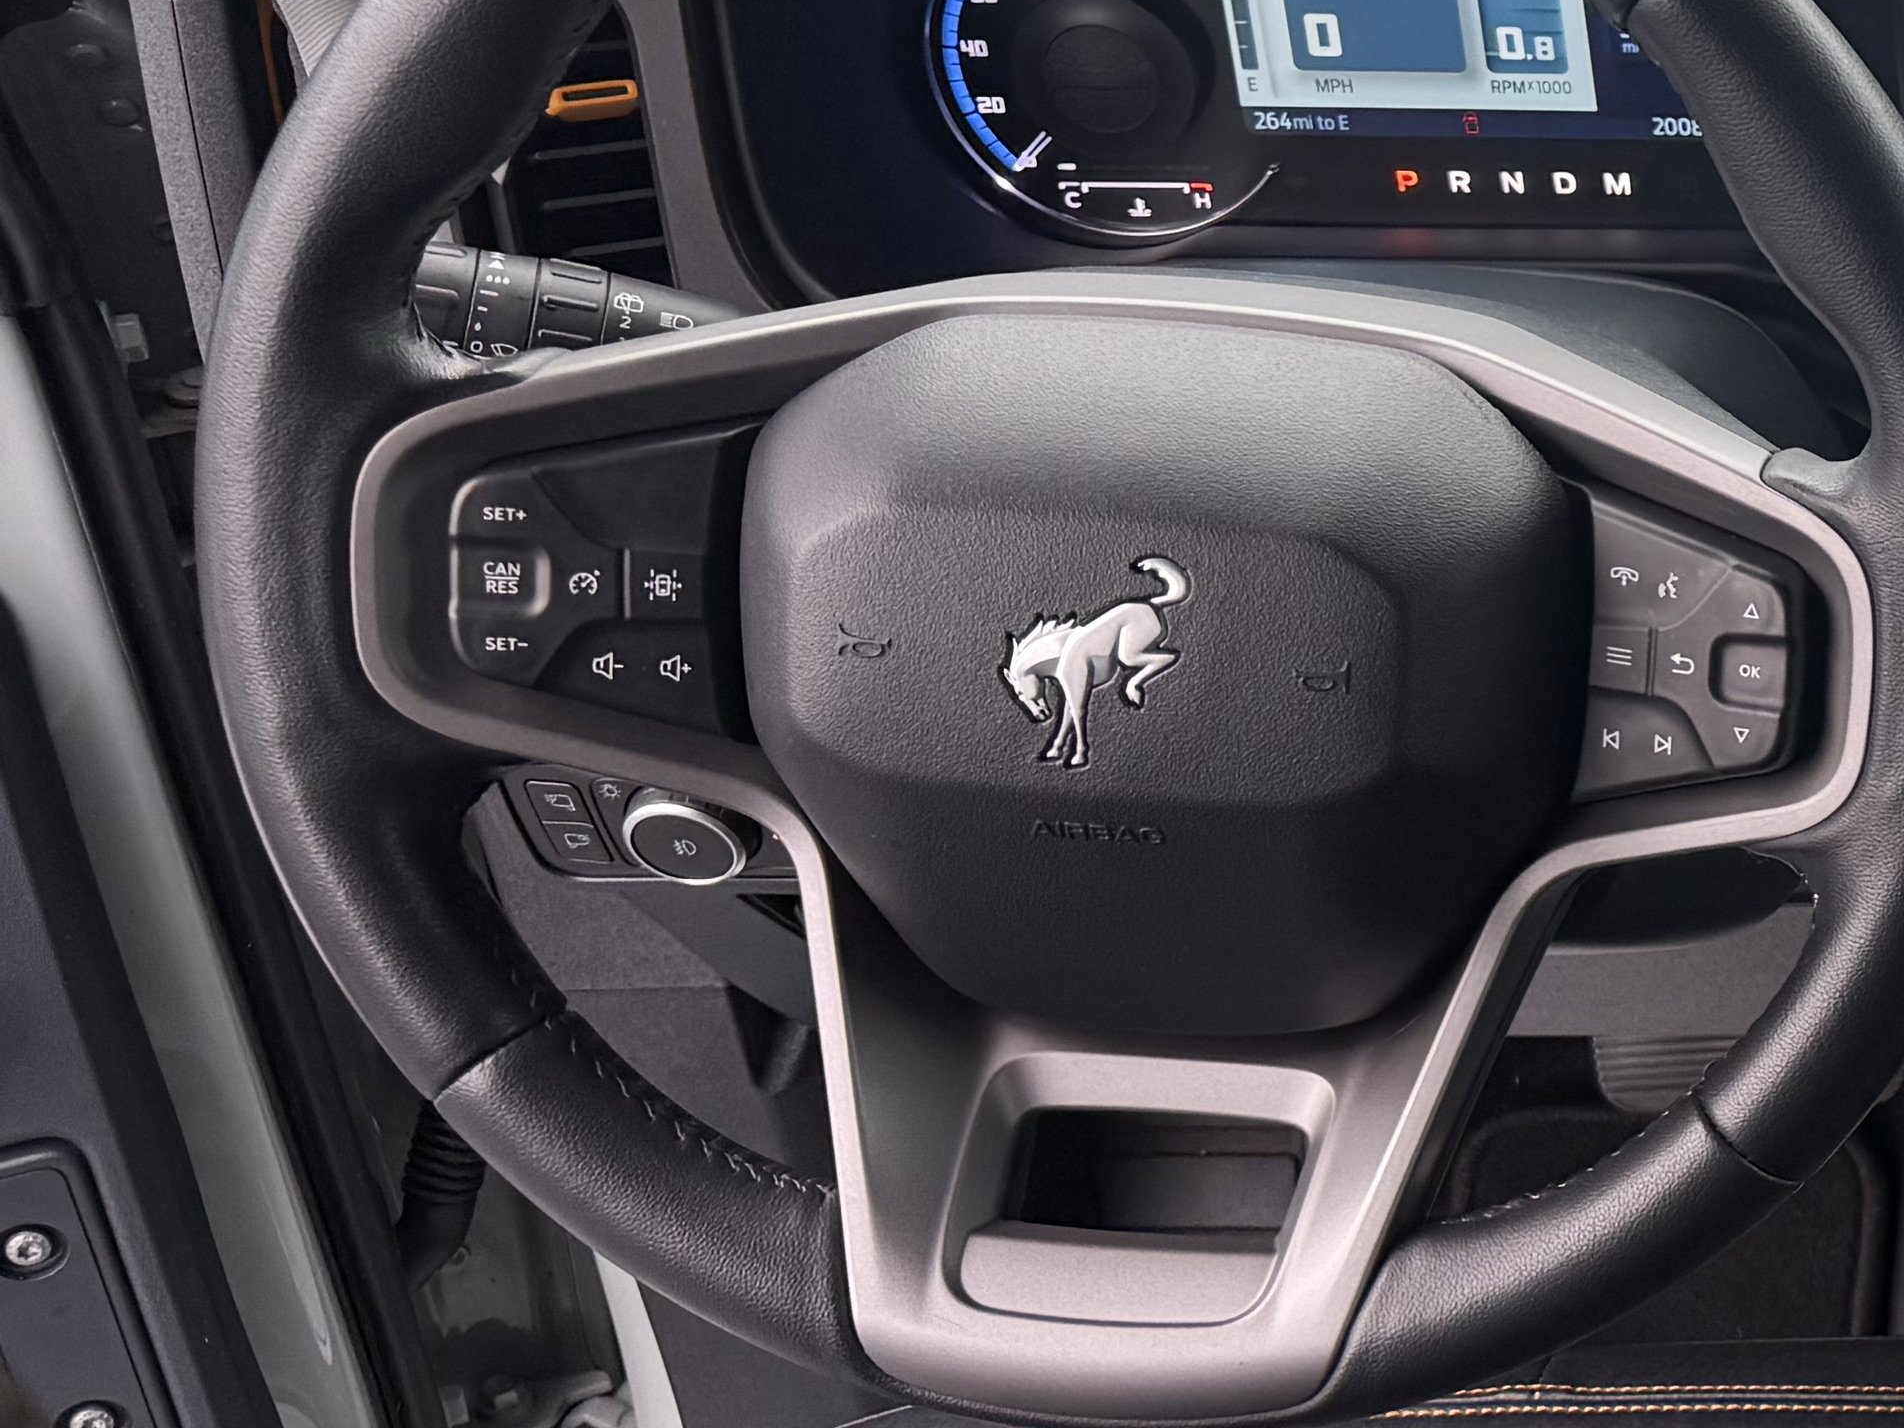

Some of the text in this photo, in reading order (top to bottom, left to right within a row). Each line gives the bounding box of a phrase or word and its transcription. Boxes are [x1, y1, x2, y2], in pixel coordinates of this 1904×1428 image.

[1303, 13, 1343, 57] 0
[959, 39, 989, 57] 40
[1496, 26, 1555, 62] 0.8
[1247, 77, 1258, 92] E
[1316, 78, 1354, 94] MPH
[975, 96, 1006, 114] 20
[1317, 117, 1336, 130] to
[1338, 115, 1350, 131] E
[1395, 170, 1632, 196] P R N D M
[1064, 192, 1082, 208] C
[1193, 192, 1212, 209] H
[483, 507, 527, 521] SET+
[483, 562, 520, 577] CAN
[485, 580, 518, 595] RES
[1739, 664, 1760, 678] OK
[1031, 820, 1166, 844] AIRBAG
